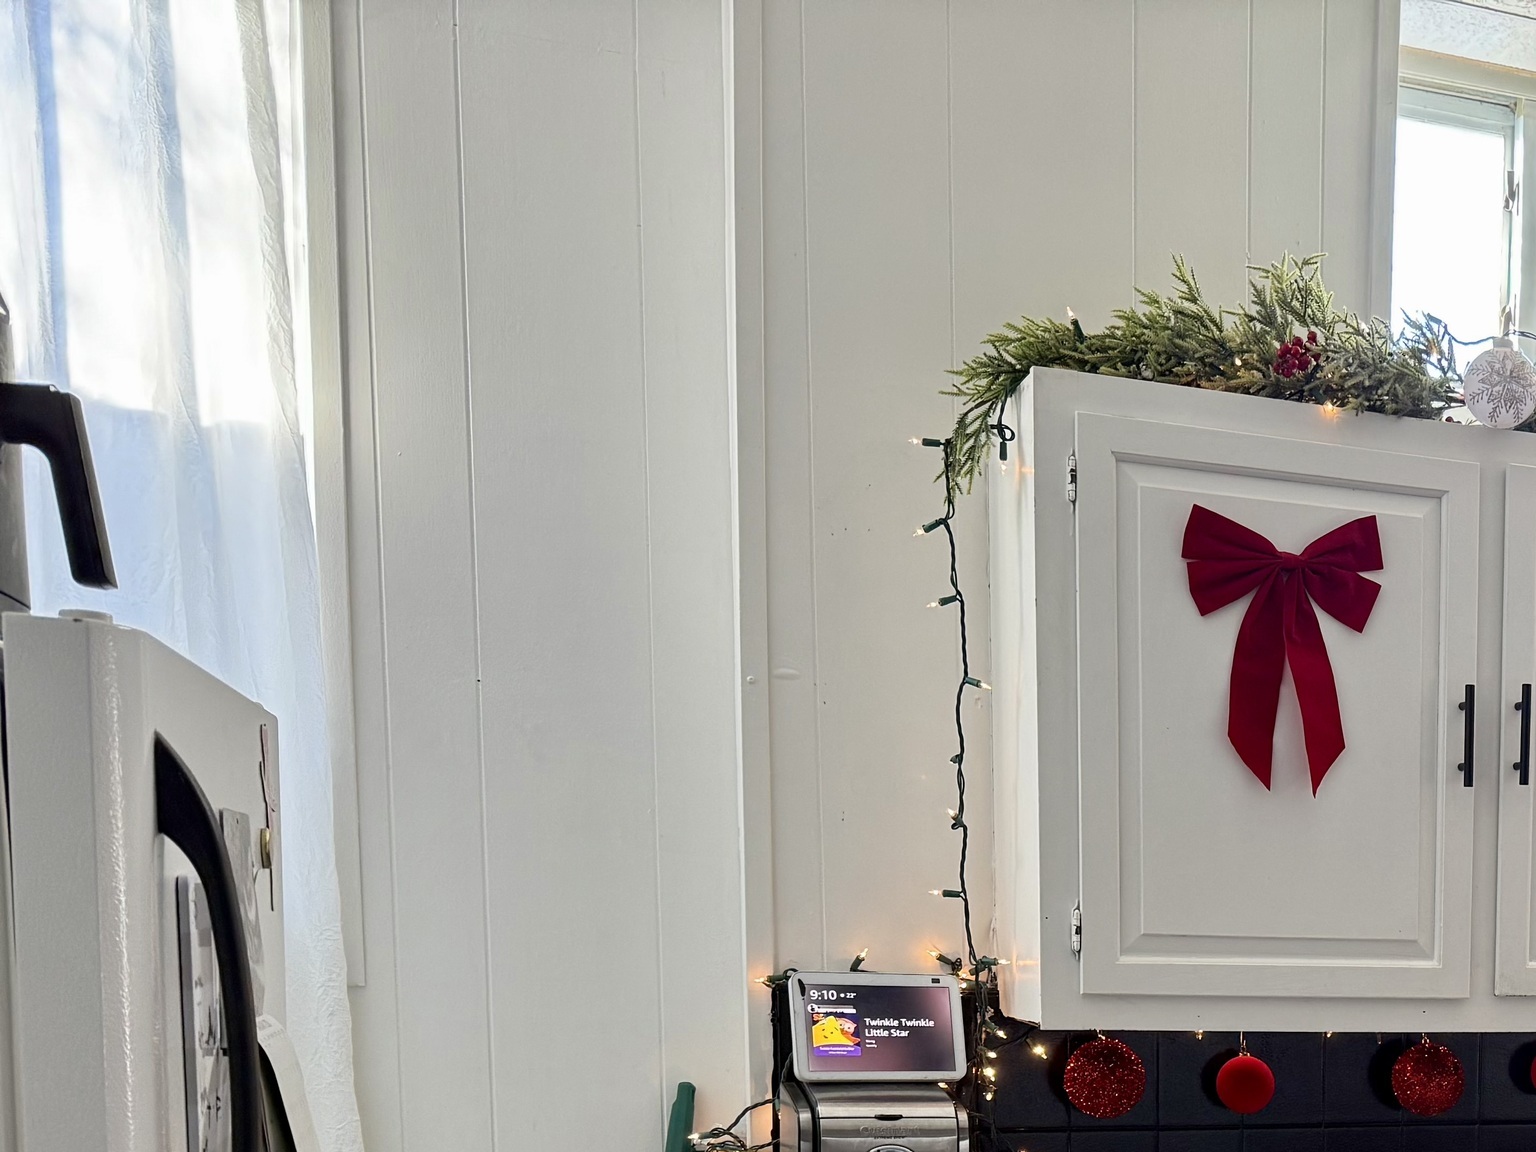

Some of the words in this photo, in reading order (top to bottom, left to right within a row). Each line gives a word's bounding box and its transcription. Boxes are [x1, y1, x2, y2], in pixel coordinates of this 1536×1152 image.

[810, 989, 837, 1000] 9:10
[864, 1018, 899, 1027] Twinkle
[900, 1018, 935, 1027] Twinkle
[865, 1028, 889, 1037] Little
[891, 1029, 910, 1037] Star
